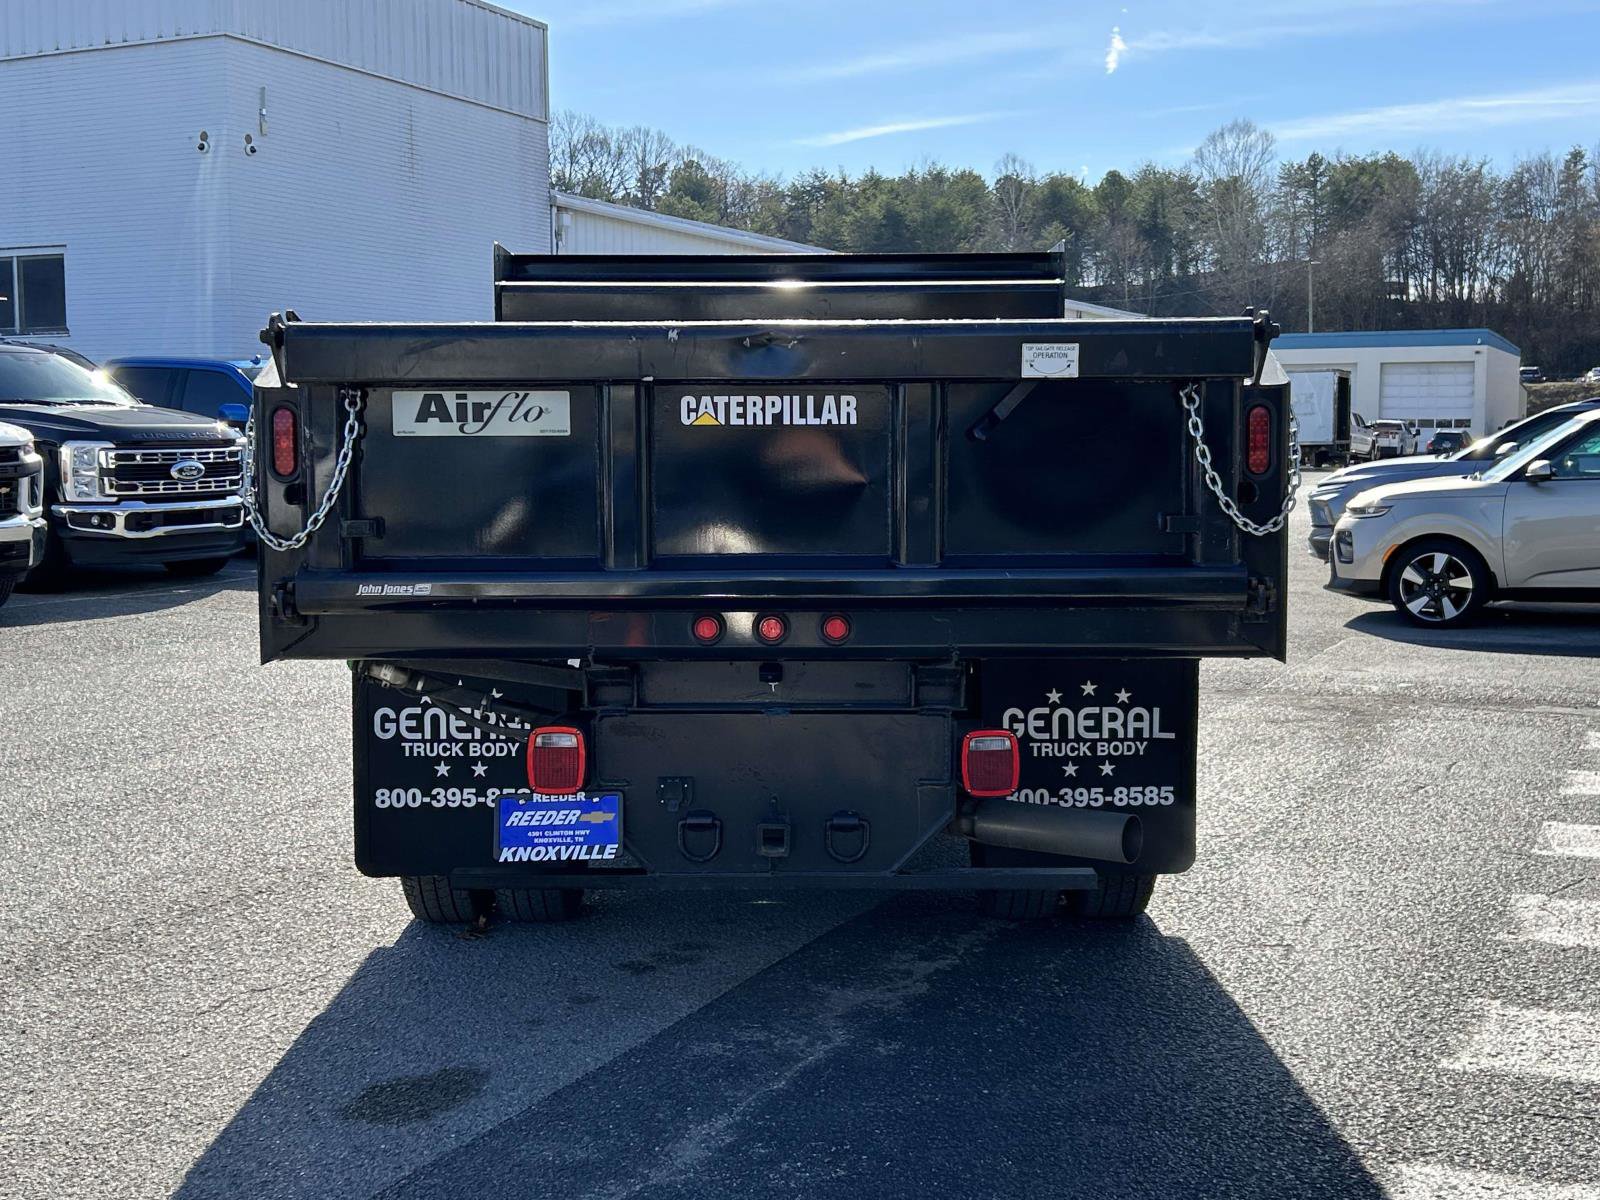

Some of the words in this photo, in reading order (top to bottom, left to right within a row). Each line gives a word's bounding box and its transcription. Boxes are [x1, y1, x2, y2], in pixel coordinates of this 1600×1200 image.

[1032, 351, 1068, 359] OPERATION
[680, 395, 857, 425] CATERPILLAR
[356, 584, 382, 596] John
[381, 584, 414, 596] Jones
[1002, 706, 1176, 739] GENERAL
[400, 742, 465, 757] TRUCK
[468, 742, 520, 757] BODY
[1029, 742, 1092, 757] TRUCK
[1096, 741, 1148, 756] BODY
[532, 791, 586, 803] REEDER
[505, 809, 582, 827] REEDER
[498, 844, 619, 862] KNOXVILLE
